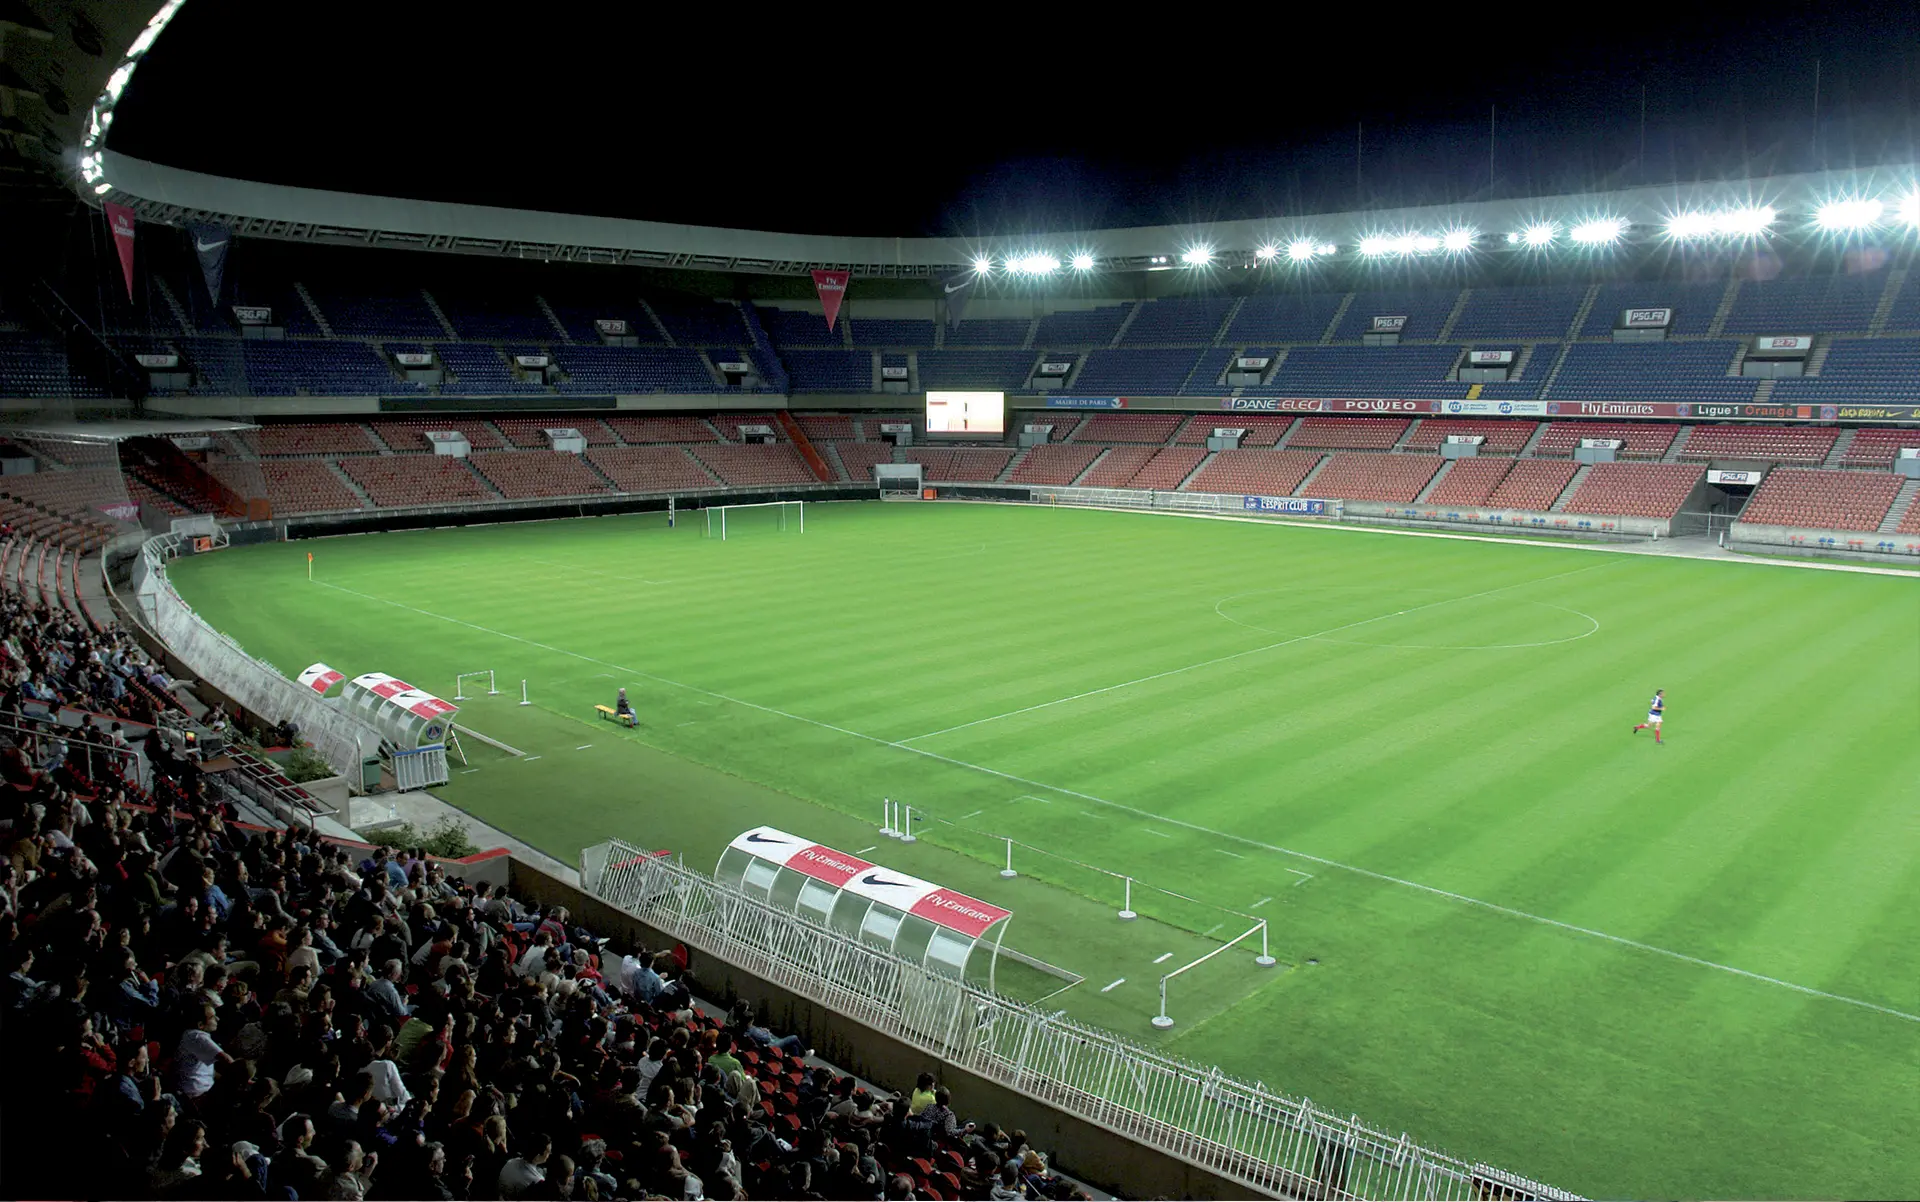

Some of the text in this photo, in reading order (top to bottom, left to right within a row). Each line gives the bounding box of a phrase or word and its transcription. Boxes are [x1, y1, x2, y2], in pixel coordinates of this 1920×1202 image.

[236, 309, 268, 320] PSG.FR
[1632, 310, 1664, 321] PSG.FR
[1377, 318, 1404, 327] PSG.FR
[1236, 399, 1319, 410] DANE-ELEC
[1345, 400, 1416, 411] POWEO
[1581, 402, 1654, 416] Fly Emirates
[1698, 405, 1731, 416] Ligue
[1745, 405, 1793, 416] Orange
[1720, 472, 1747, 481] PSG.FR
[1289, 501, 1307, 511] CLUB
[800, 850, 857, 875] Fly Emirates
[925, 894, 993, 922] Fly Emirates
